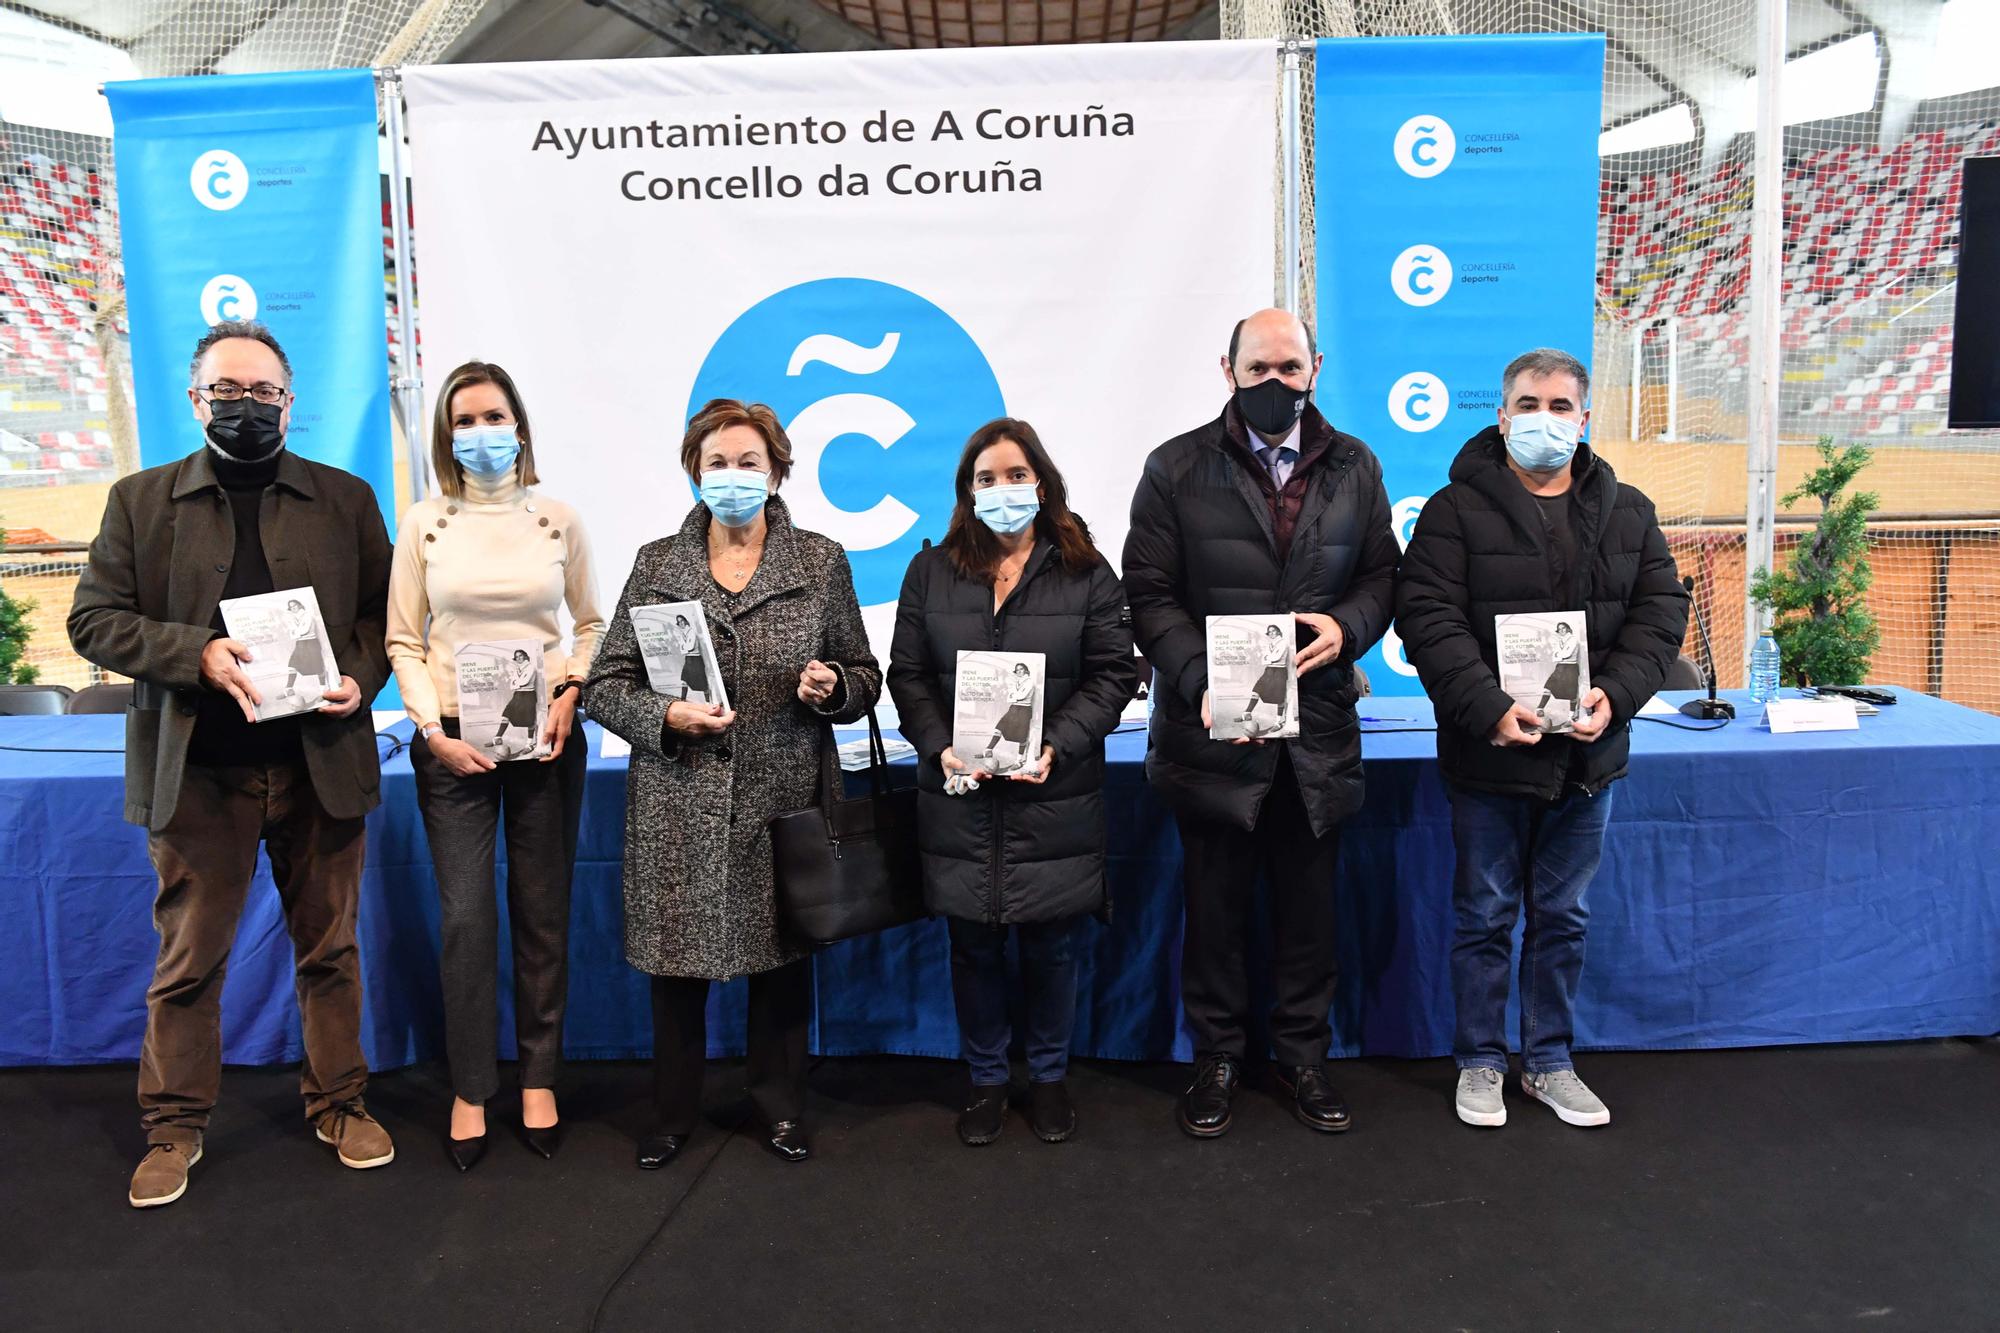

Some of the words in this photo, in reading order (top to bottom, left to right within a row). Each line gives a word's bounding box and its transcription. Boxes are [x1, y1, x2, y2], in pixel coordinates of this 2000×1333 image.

[532, 114, 847, 160] Ayuntamiento
[863, 110, 915, 143] de
[930, 110, 964, 141] A
[976, 105, 1135, 140] Coruña
[1464, 146, 1502, 154] deportes
[257, 179, 292, 188] deportes
[621, 165, 803, 201] Concello
[818, 163, 869, 197] da
[886, 160, 1042, 195] Coruña
[1461, 275, 1499, 284] deportes
[266, 303, 301, 312] deportes
[1458, 402, 1495, 411] deportes
